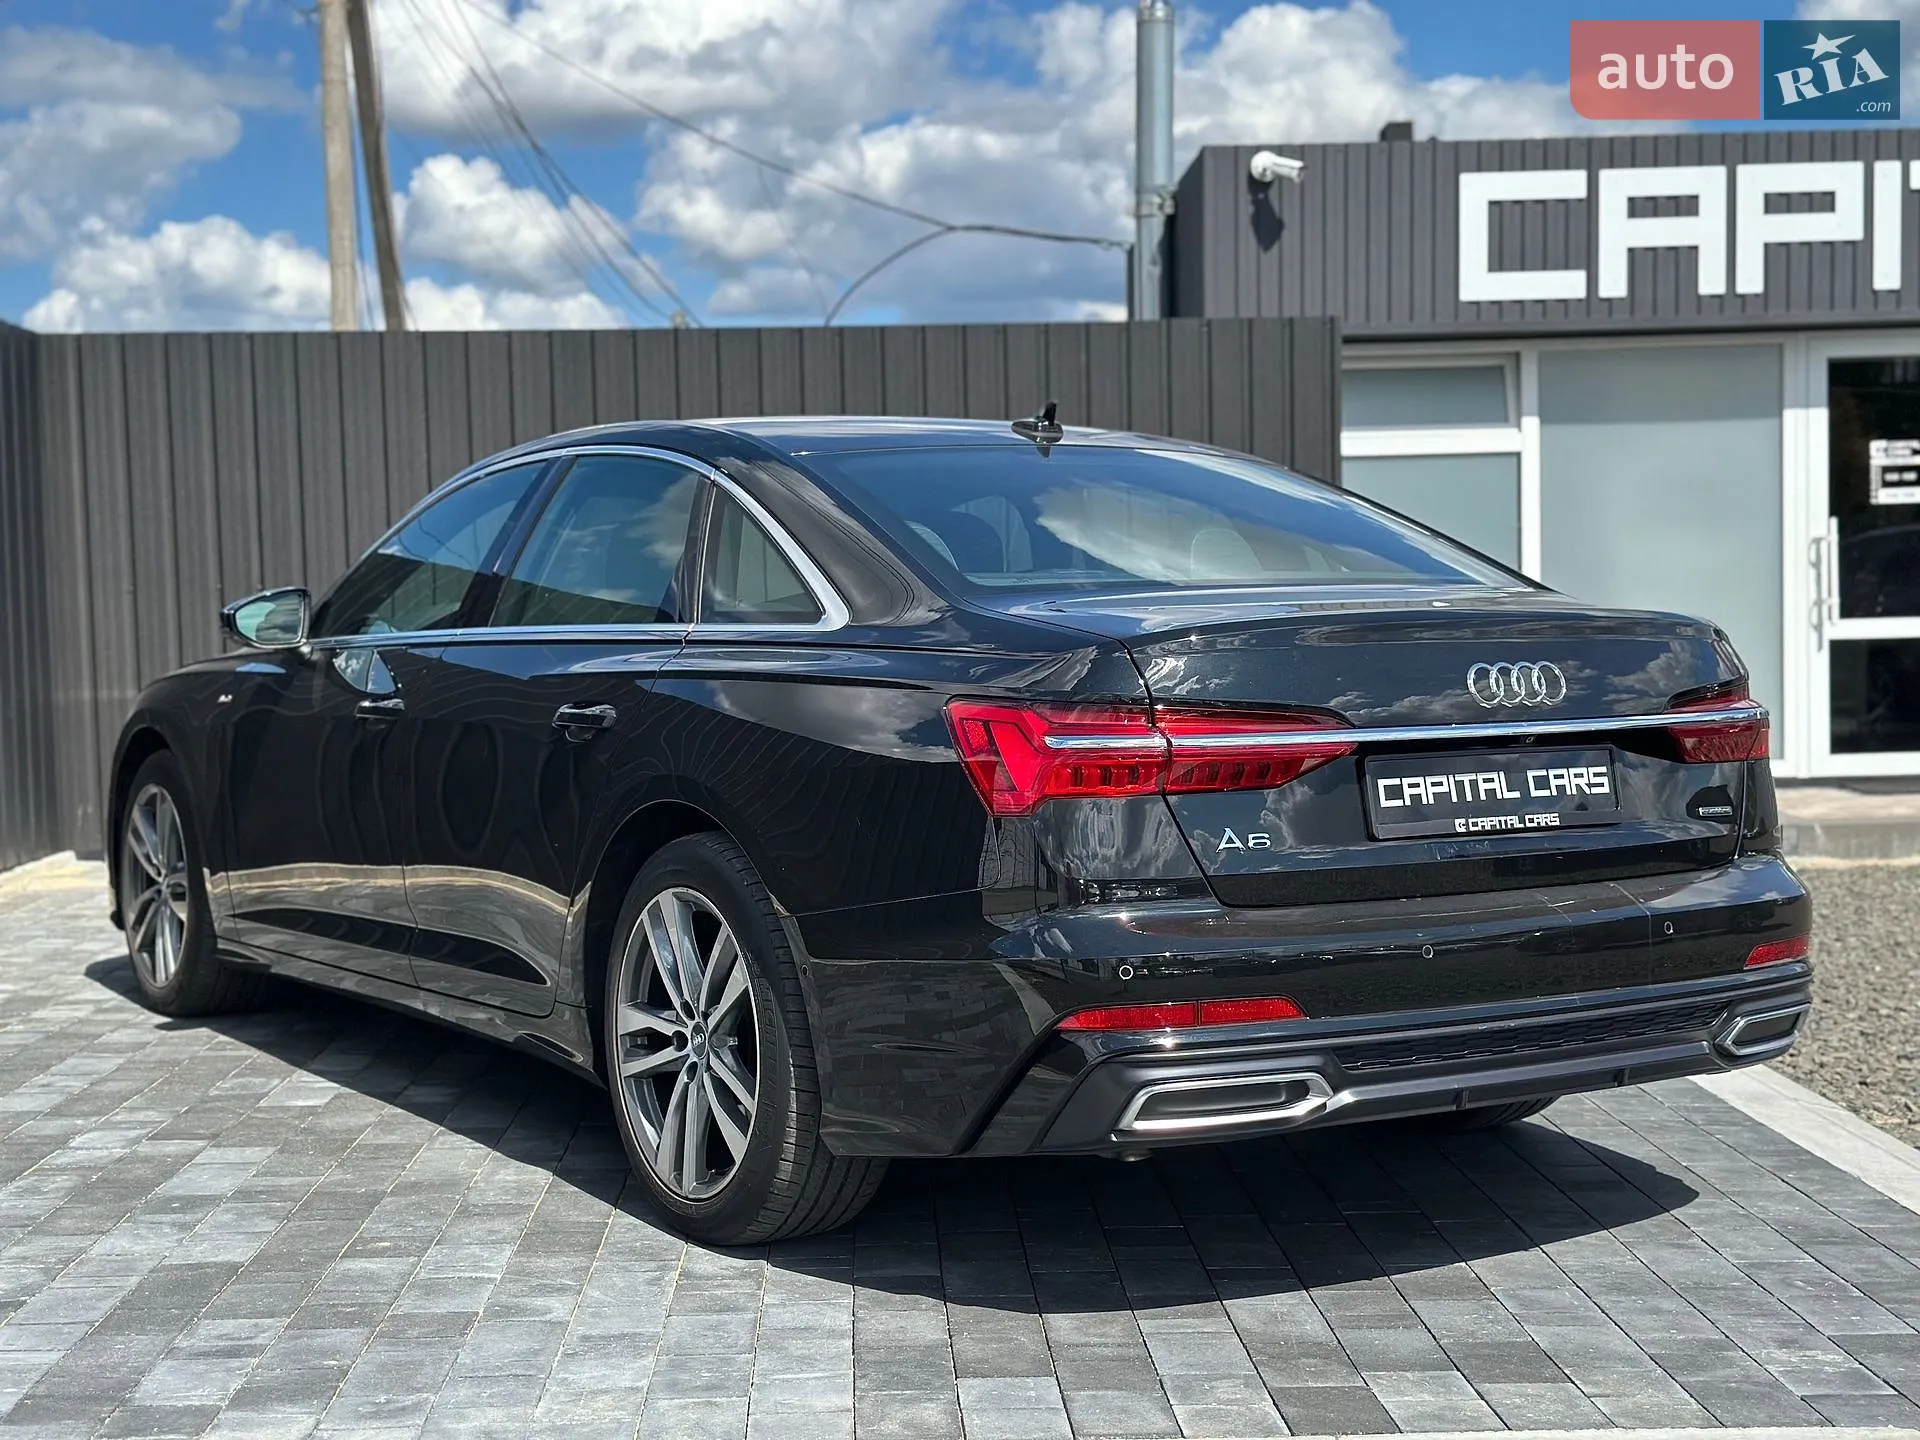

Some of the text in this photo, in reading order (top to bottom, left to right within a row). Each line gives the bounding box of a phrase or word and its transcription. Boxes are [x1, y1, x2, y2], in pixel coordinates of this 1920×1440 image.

[1459, 160, 1920, 302] CAPI
[1376, 765, 1611, 809] CAPITAL CARS
[1468, 812, 1560, 831] CAPITAL CARS
[1216, 827, 1271, 854] A6
